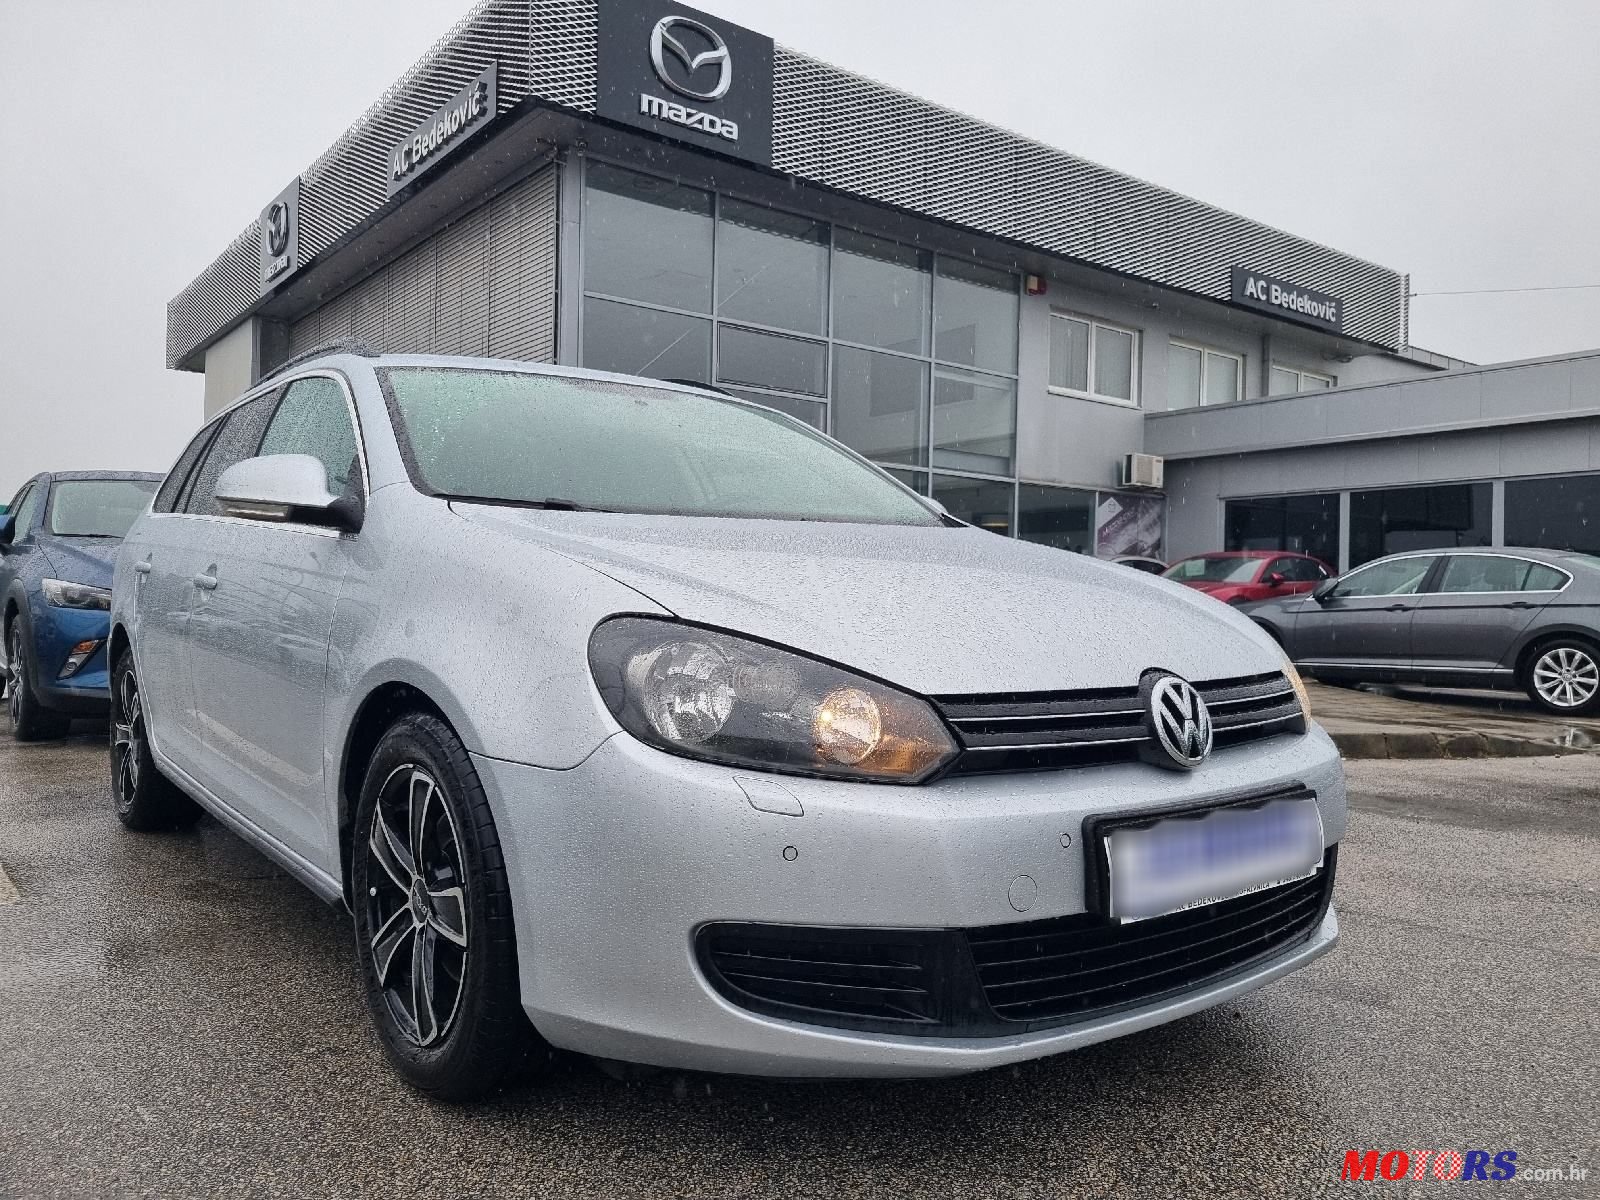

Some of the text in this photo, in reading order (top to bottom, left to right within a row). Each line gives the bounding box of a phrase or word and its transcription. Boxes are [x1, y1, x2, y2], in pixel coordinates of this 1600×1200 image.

[392, 81, 481, 180] AC Bedeković
[640, 93, 738, 141] mazda
[1244, 277, 1336, 322] AC Bedeković
